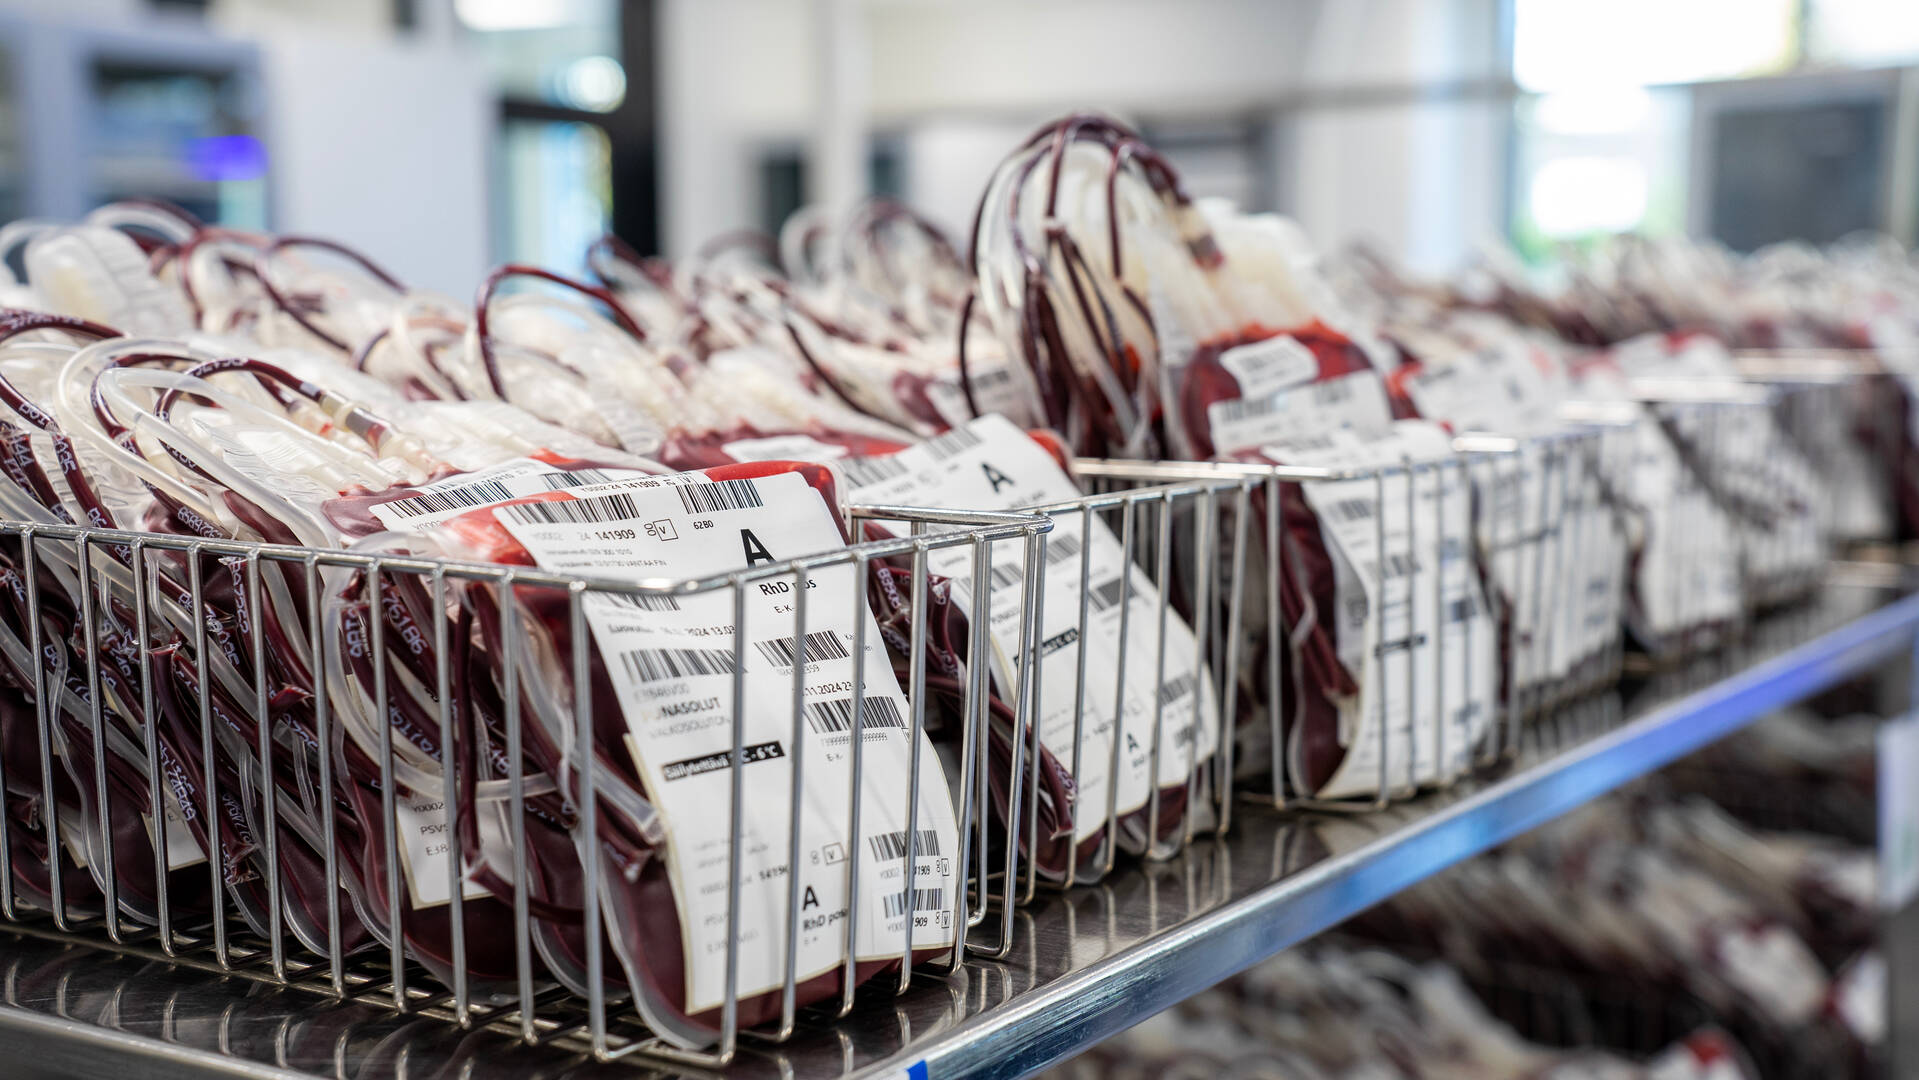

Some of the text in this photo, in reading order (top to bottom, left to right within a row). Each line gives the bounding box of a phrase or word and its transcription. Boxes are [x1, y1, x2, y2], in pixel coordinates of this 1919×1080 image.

[981, 461, 1015, 493] A
[594, 528, 636, 542] 141909
[693, 520, 714, 530] 62B0
[740, 528, 777, 569] A
[758, 581, 790, 596] RhD
[803, 885, 819, 912] A
